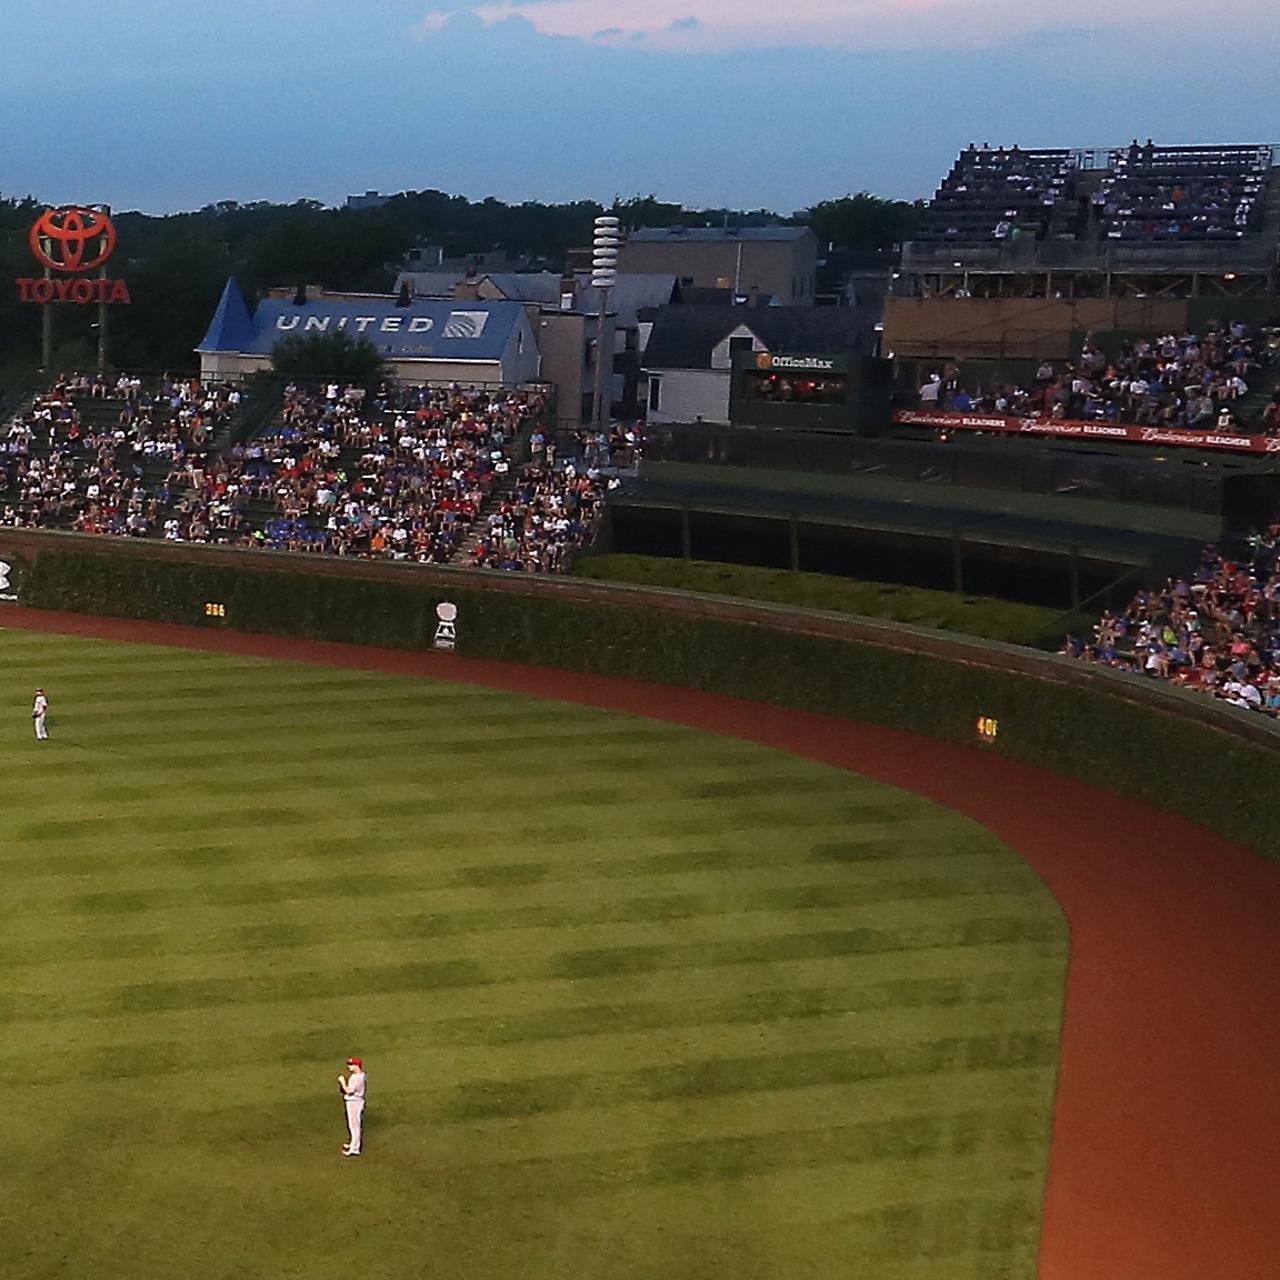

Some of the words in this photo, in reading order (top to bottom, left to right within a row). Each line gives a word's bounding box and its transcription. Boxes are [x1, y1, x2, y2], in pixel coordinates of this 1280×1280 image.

[16, 278, 131, 304] TOYOTA
[276, 315, 434, 332] UNITED
[771, 356, 833, 369] OfficeMax
